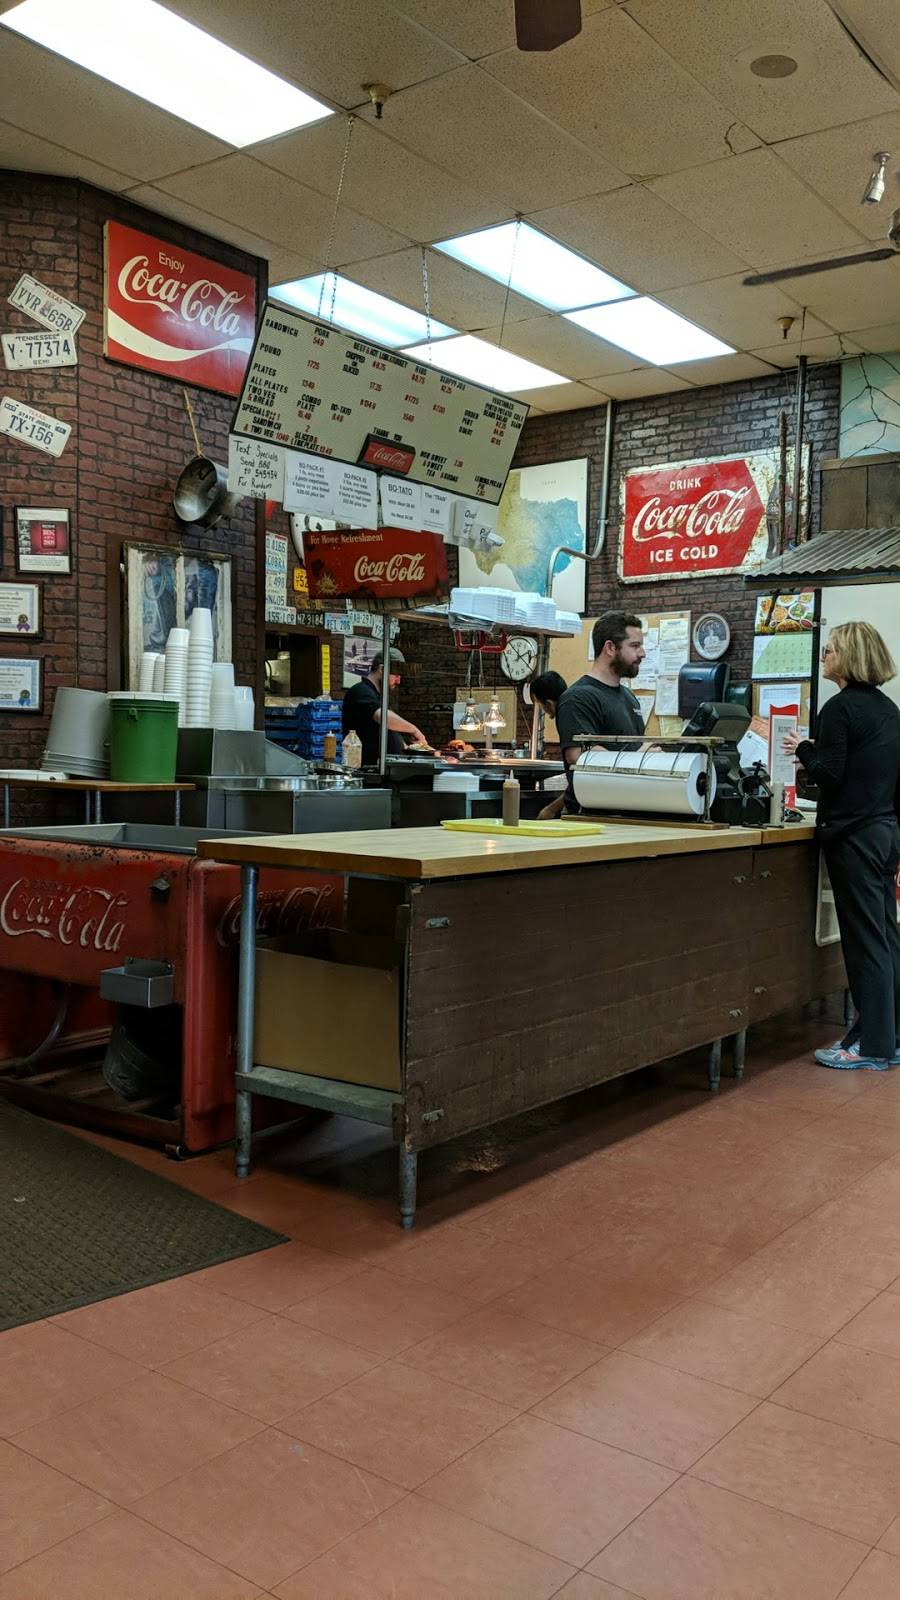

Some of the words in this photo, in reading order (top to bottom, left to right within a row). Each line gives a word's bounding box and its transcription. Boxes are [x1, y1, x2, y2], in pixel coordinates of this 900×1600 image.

[159, 251, 185, 274] Enjoy
[45, 289, 64, 305] TEXAS
[118, 255, 246, 336] Coca-Cola
[264, 318, 299, 337] SANDWICH
[314, 326, 330, 339] PORK
[259, 342, 282, 357] POUND
[253, 362, 277, 377] PLATES
[250, 375, 262, 386] ALL
[263, 379, 289, 394] PLATES
[263, 388, 276, 400] VEG
[253, 396, 275, 408] BREAD
[296, 400, 316, 413] PLATE
[263, 428, 275, 438] VEG
[233, 440, 252, 455] Text
[240, 456, 255, 467] Send
[426, 468, 436, 478] TEA
[669, 477, 702, 492] DRINK
[631, 486, 753, 543] Coca-Cola
[650, 549, 674, 563] ICE
[680, 544, 719, 561] COLD
[353, 552, 426, 583] Coca-Cola
[0, 877, 129, 953] Coca-Cola
